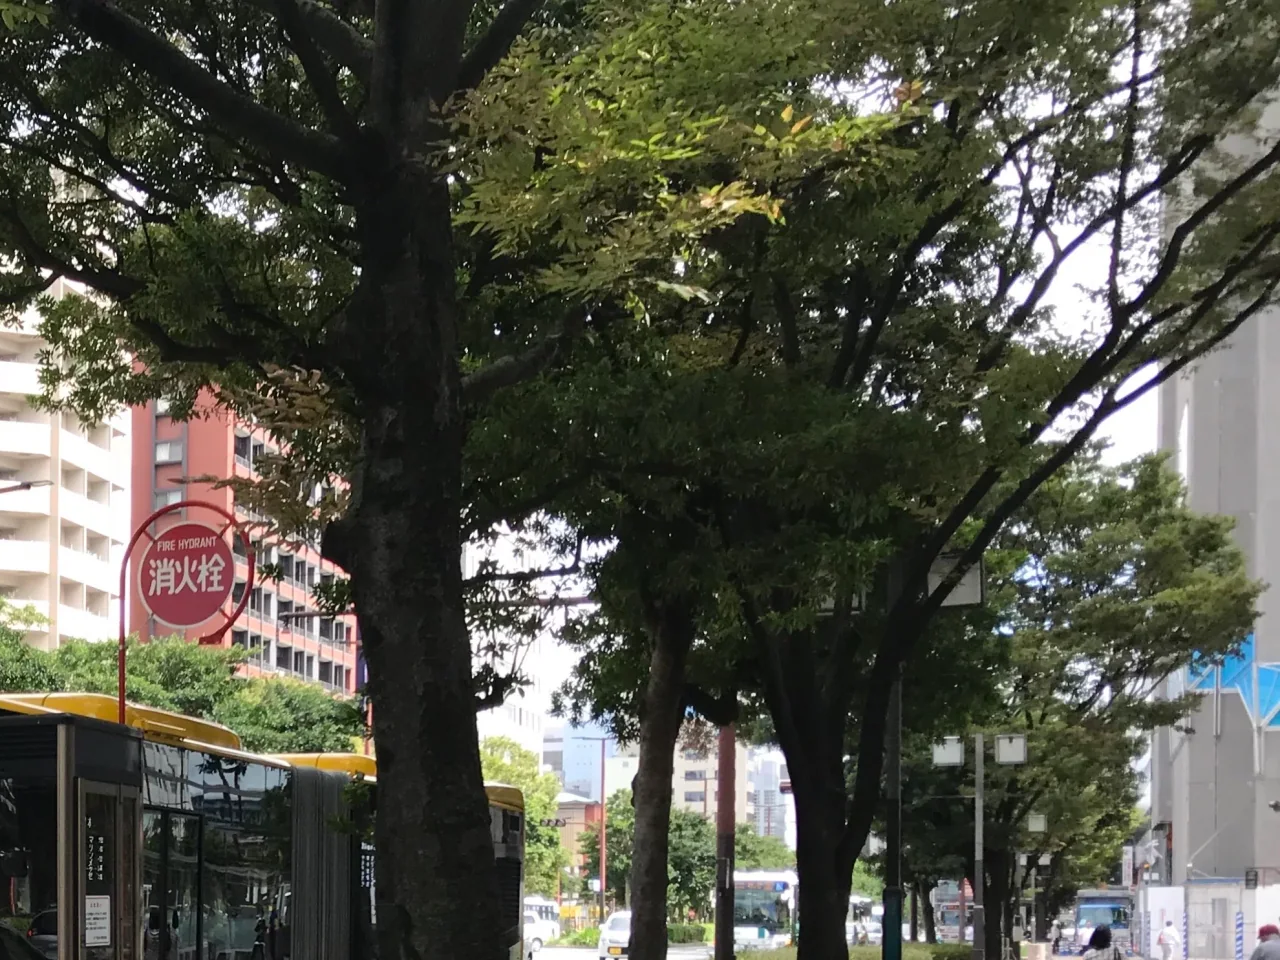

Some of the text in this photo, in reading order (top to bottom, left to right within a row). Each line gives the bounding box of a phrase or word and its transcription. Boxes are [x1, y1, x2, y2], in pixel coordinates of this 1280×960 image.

[157, 536, 218, 552] FIRE HYDRANT
[148, 553, 226, 596] 消火栓
